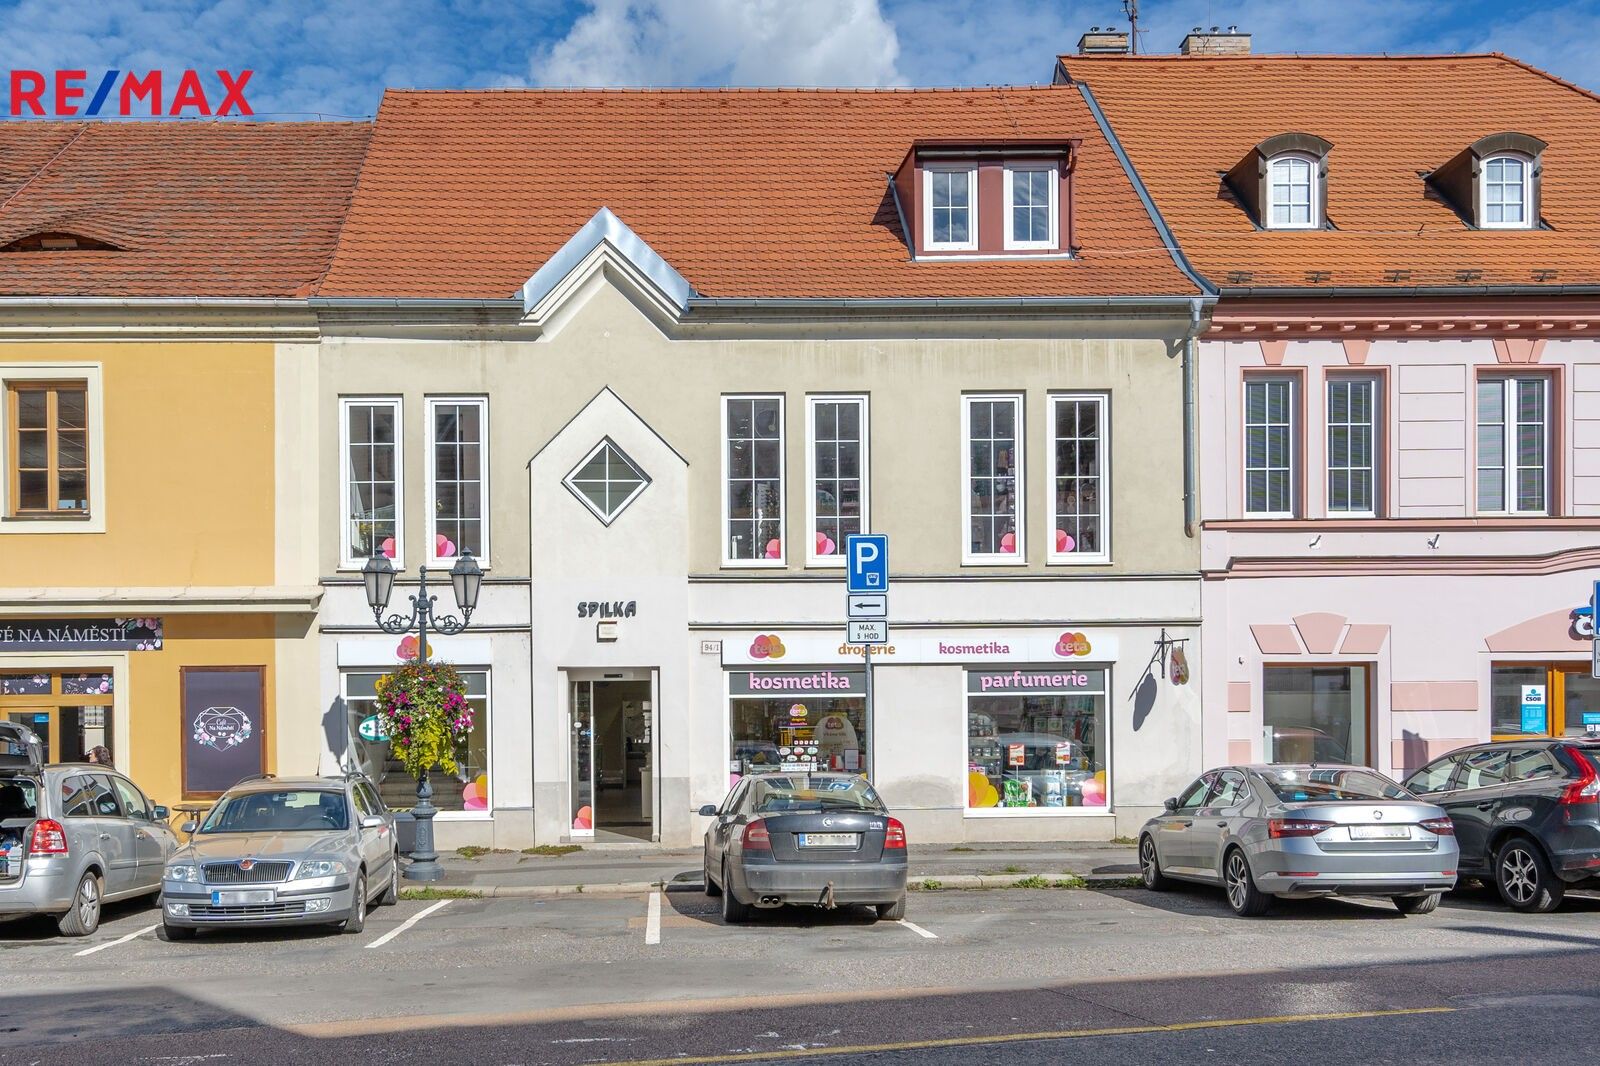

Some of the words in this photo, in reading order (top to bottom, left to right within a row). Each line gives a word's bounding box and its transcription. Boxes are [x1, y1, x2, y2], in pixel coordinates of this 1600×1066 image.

[856, 542, 879, 574] P
[577, 600, 637, 618] SPILKA
[18, 628, 44, 643] NA
[47, 625, 127, 642] NÁMĚSTÍ
[753, 643, 782, 655] teta
[838, 643, 896, 658] drogerie
[938, 641, 1010, 655] kosmetika
[1057, 640, 1089, 652] teta
[749, 671, 851, 690] kosmetika
[980, 670, 1088, 692] parfumerie
